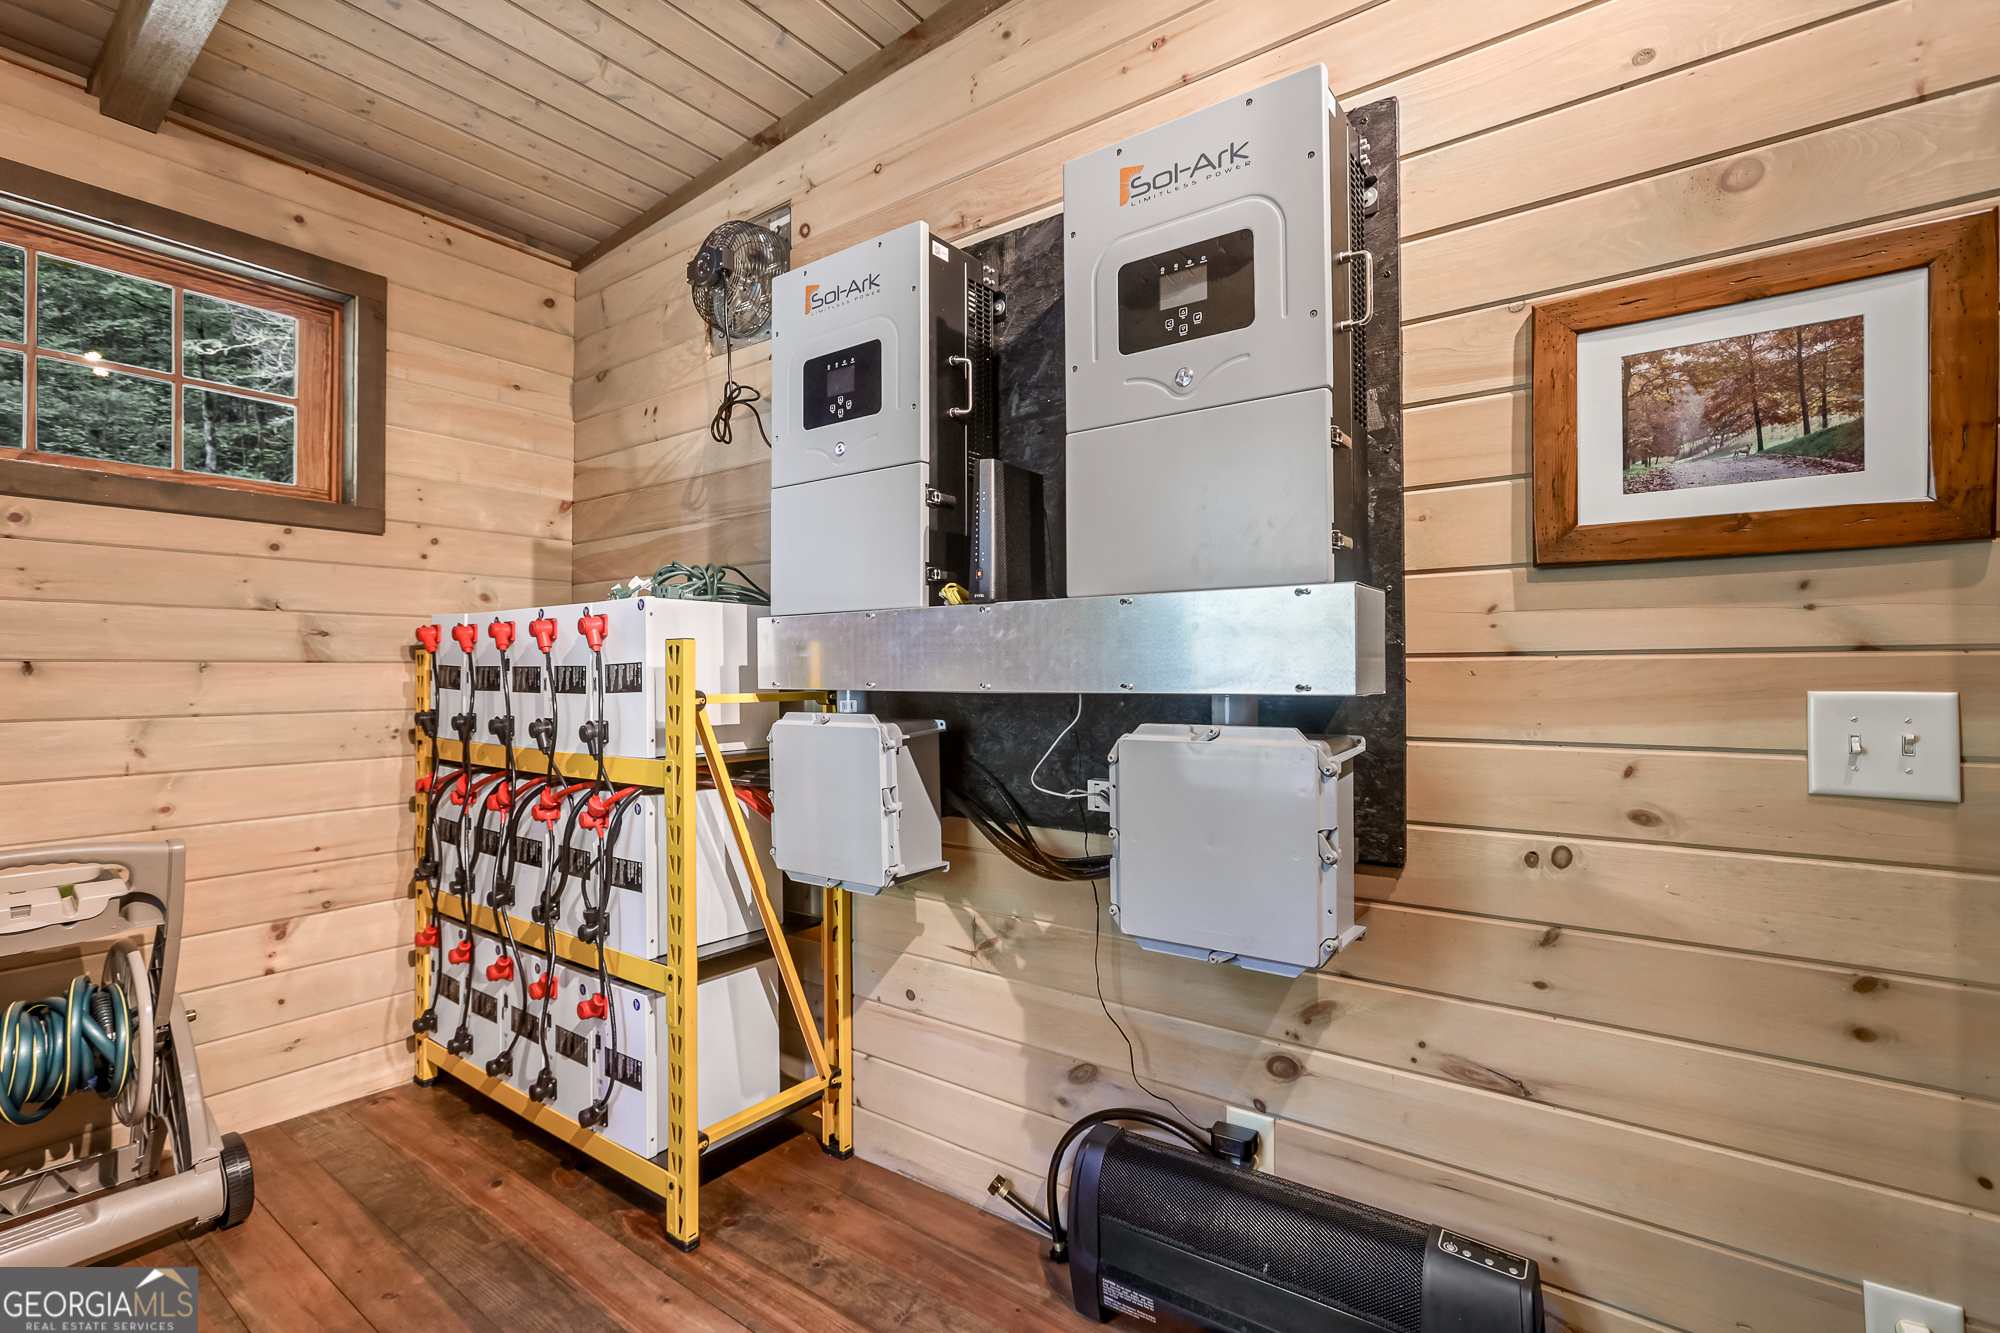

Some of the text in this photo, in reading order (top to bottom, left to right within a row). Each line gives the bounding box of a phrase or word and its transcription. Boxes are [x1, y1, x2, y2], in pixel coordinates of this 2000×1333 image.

[1130, 141, 1249, 199] Sol-Ark
[1130, 160, 1251, 207] LIMITLESS POWER
[810, 288, 881, 316] LIMITLESS POWER
[811, 273, 881, 310] Sol-Ark
